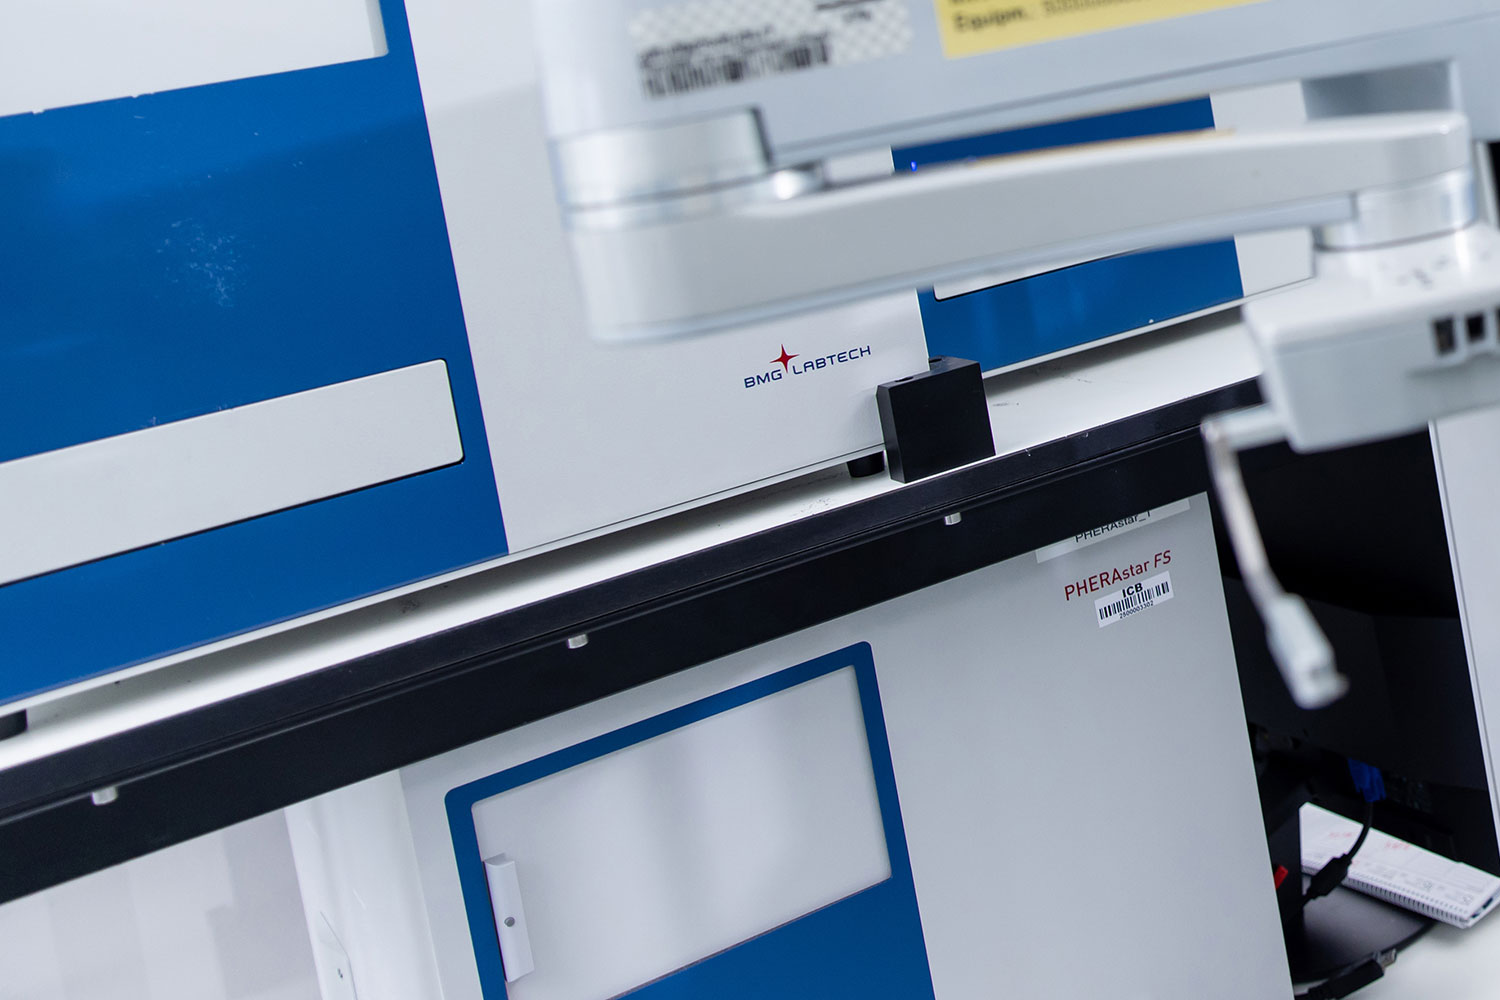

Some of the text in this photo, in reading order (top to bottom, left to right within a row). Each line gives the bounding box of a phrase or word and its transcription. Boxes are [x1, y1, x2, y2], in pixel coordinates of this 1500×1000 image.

[744, 345, 872, 389] BMG LABTECH
[1064, 550, 1171, 601] PHERAstar FS
[1122, 582, 1143, 598] ICB
